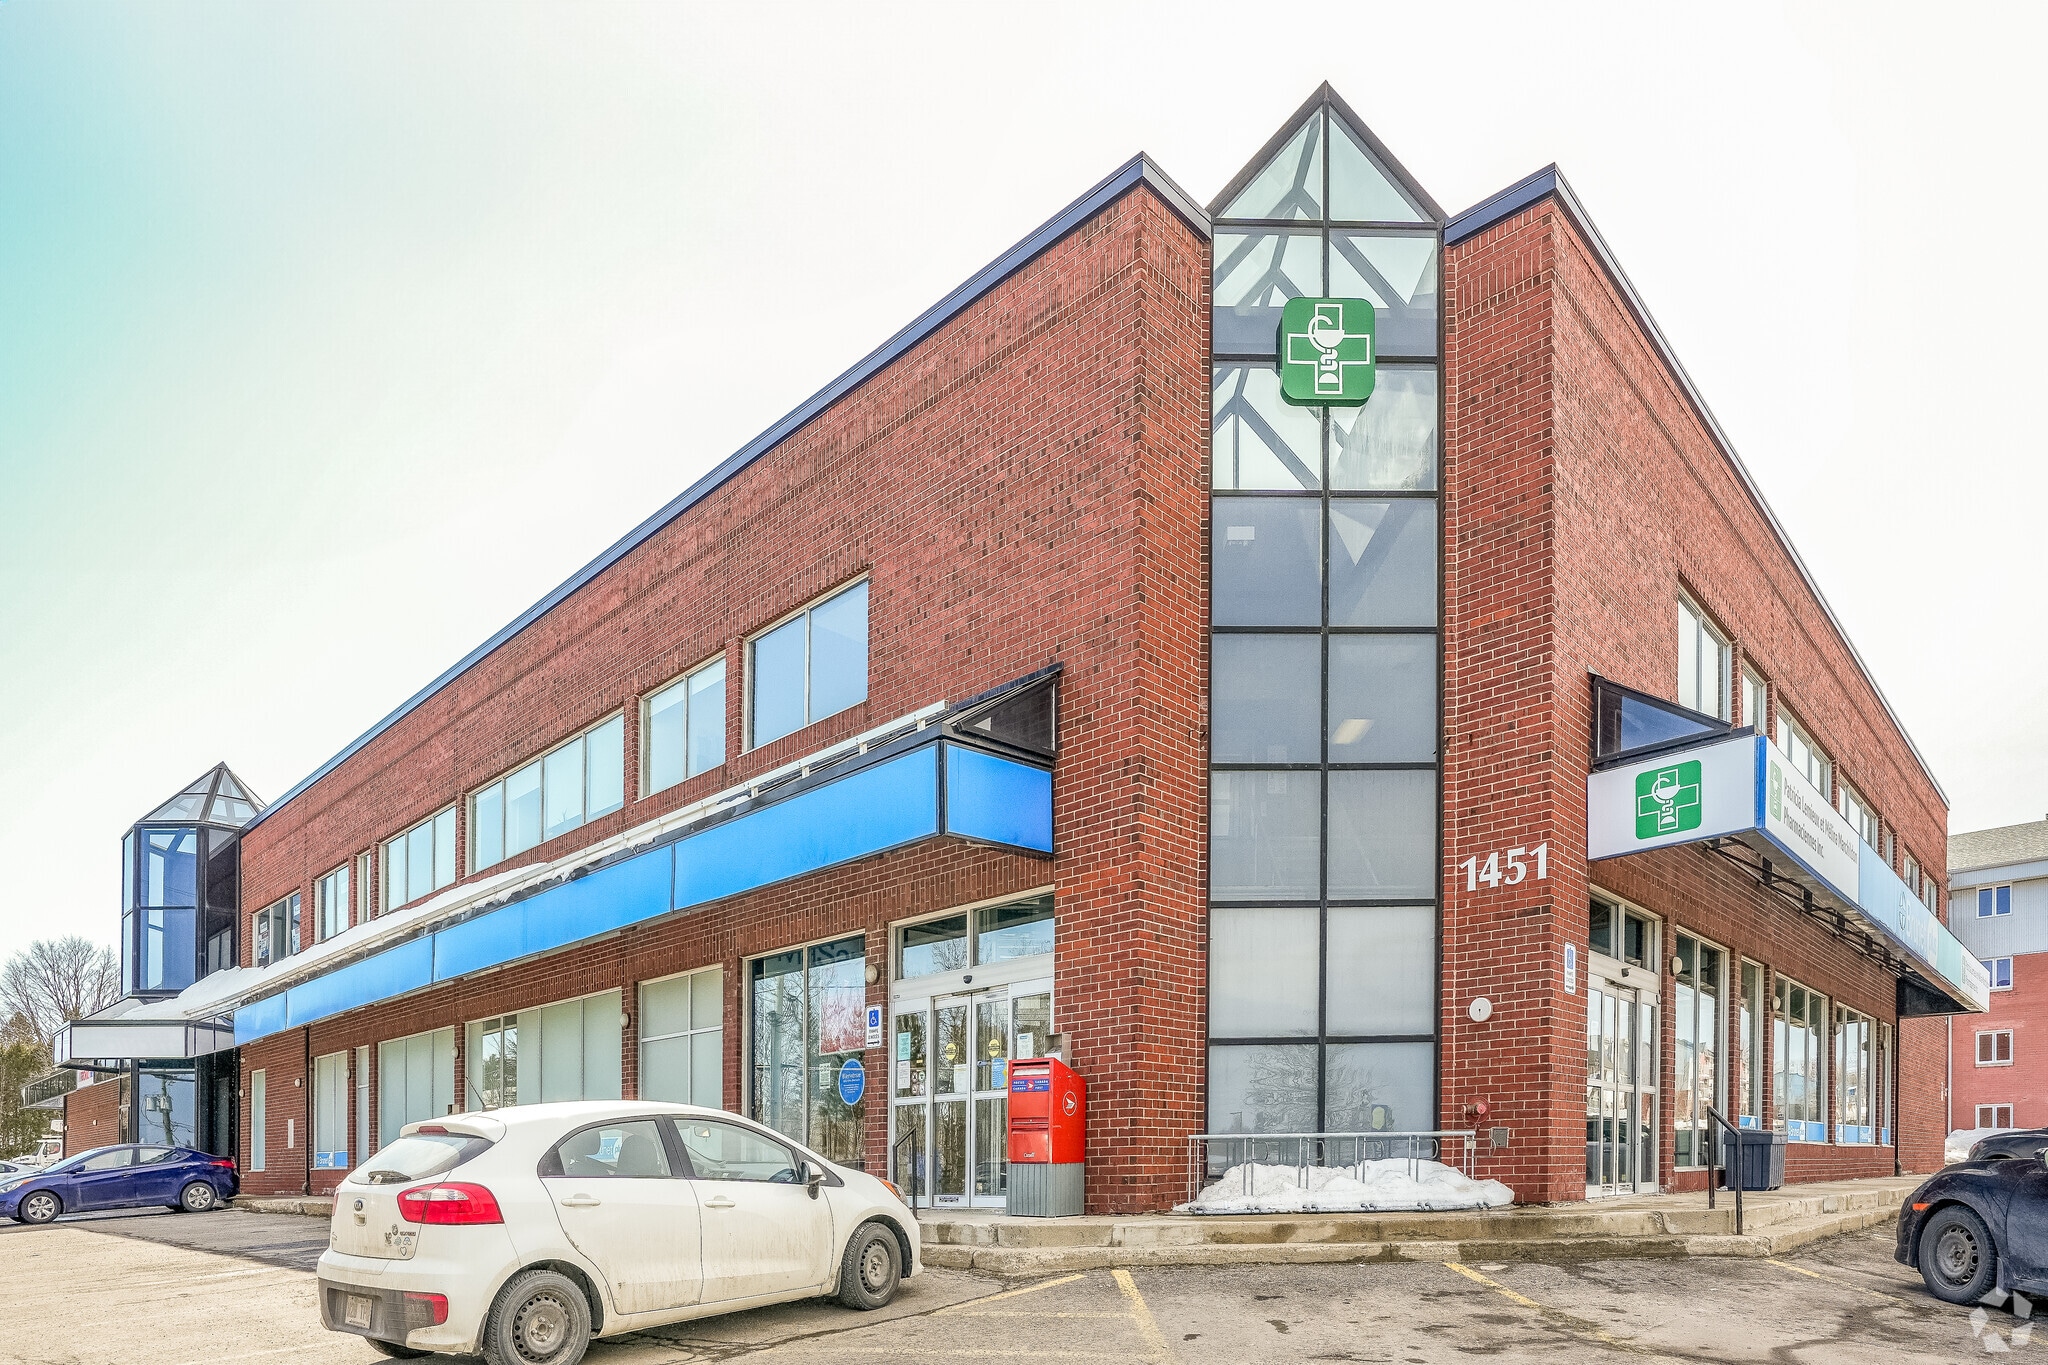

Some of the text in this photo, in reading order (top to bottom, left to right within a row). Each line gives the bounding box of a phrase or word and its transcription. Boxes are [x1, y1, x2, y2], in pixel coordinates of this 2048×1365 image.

[1783, 806, 1817, 852] Pharmaciennes
[1784, 777, 1801, 810] Patricia
[1802, 796, 1820, 828] Lemieux
[1820, 818, 1825, 833] et
[1459, 842, 1547, 892] 1451
